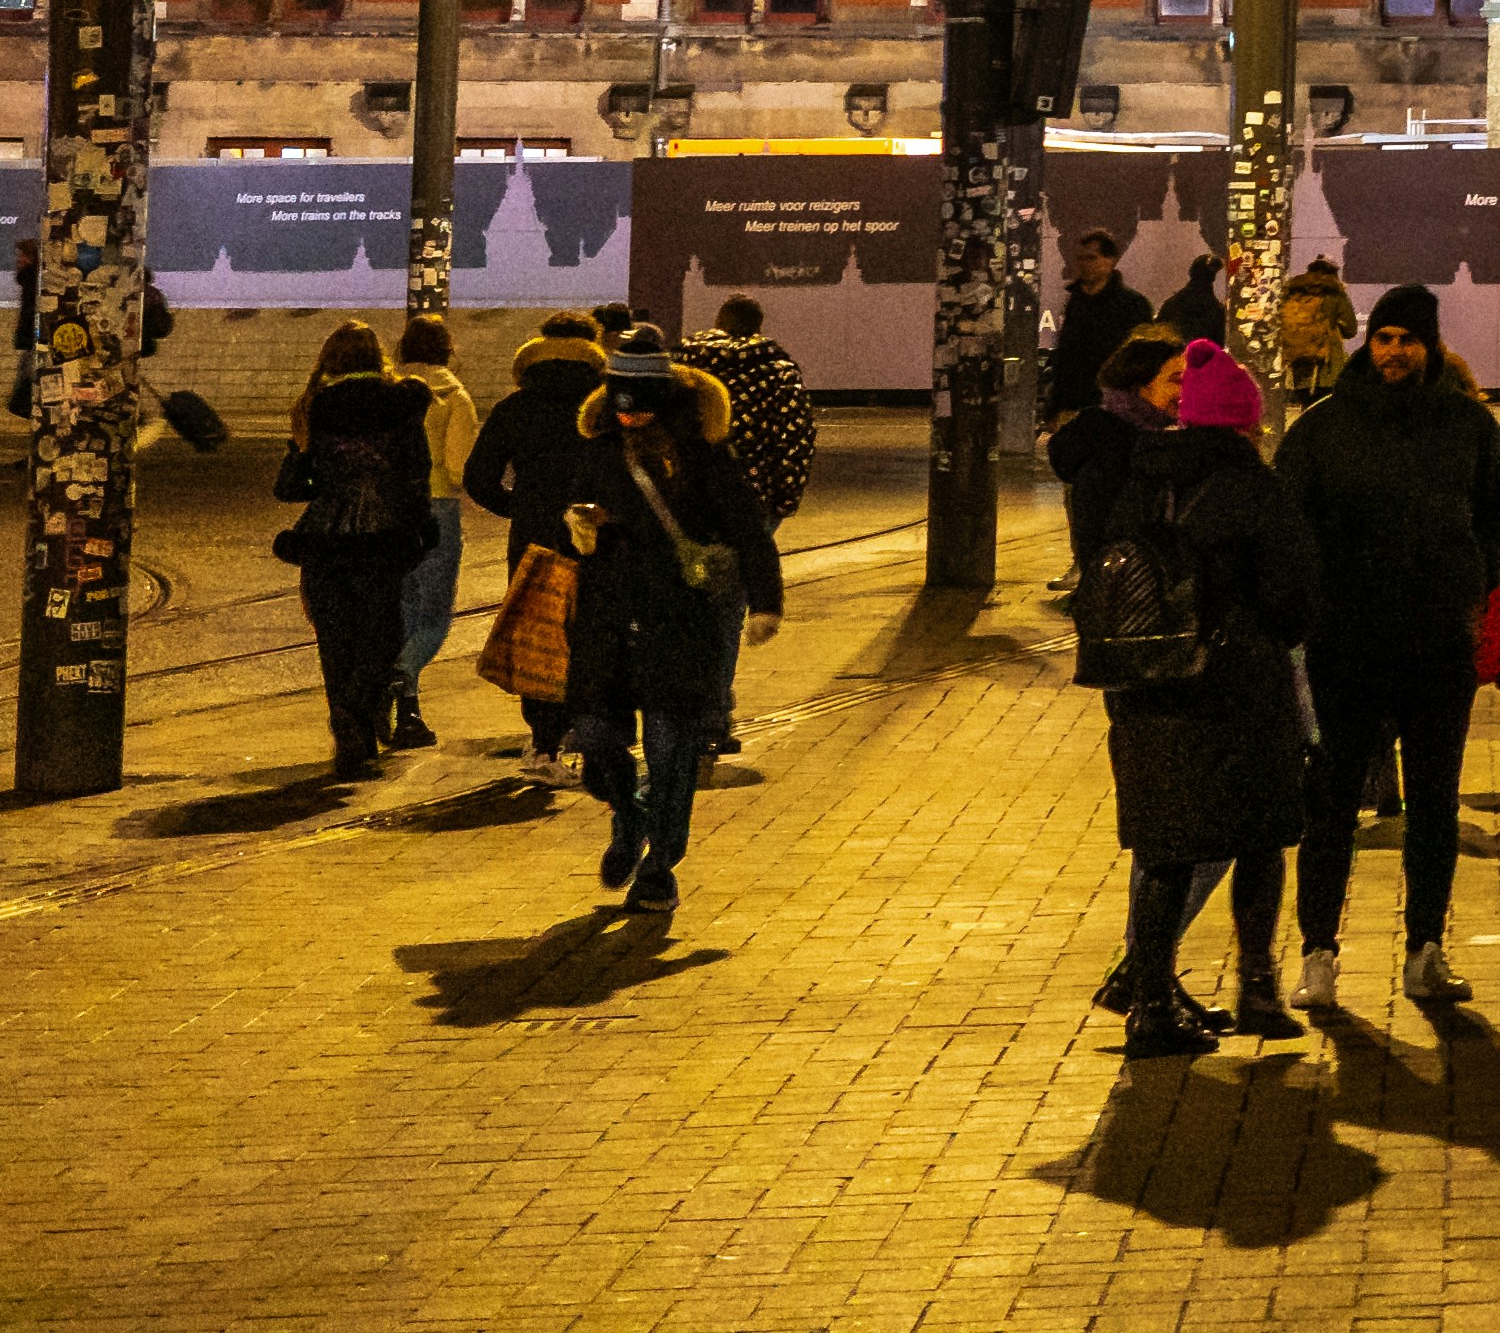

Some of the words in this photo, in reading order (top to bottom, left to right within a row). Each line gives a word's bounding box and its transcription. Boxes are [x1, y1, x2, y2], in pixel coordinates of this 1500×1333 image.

[236, 193, 263, 203] More
[265, 195, 297, 205] space
[300, 192, 315, 202] for
[317, 192, 365, 202] travellers
[1465, 194, 1498, 206] More
[705, 200, 736, 212] Meer
[738, 200, 776, 211] ruimte
[780, 202, 806, 211] voor
[809, 200, 860, 214] reizigers
[271, 211, 298, 221] More
[301, 210, 330, 221] trains
[333, 212, 346, 220] on
[349, 210, 366, 220] the
[369, 210, 401, 220] tracks
[745, 220, 777, 232] Meer
[778, 221, 820, 232] treinen
[823, 222, 839, 234] op
[842, 220, 862, 231] het
[864, 222, 899, 233] spoor
